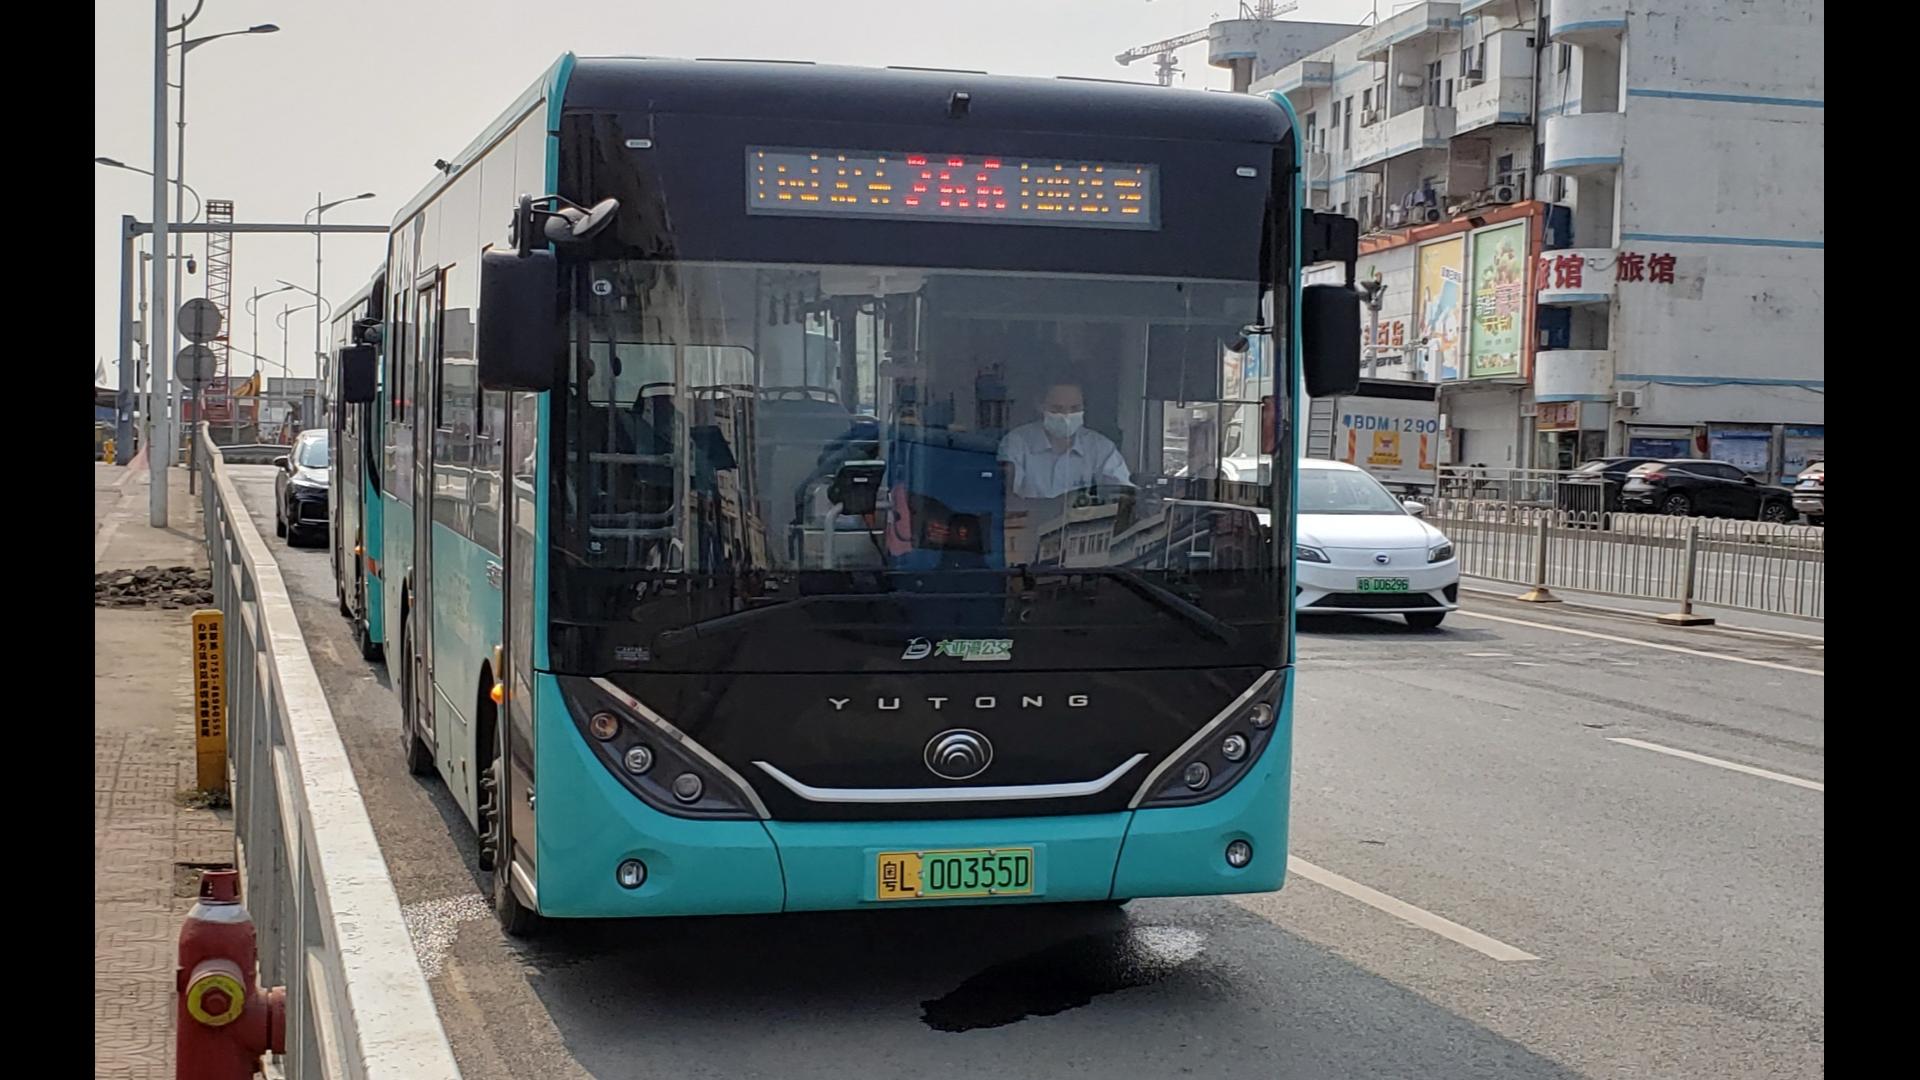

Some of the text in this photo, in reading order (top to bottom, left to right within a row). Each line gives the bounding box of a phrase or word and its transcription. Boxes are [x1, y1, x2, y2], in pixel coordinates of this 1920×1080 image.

[1616, 251, 1677, 284] 旅馆
[828, 695, 1089, 710] YUTONG
[882, 855, 1030, 892] 粤L 00355D
